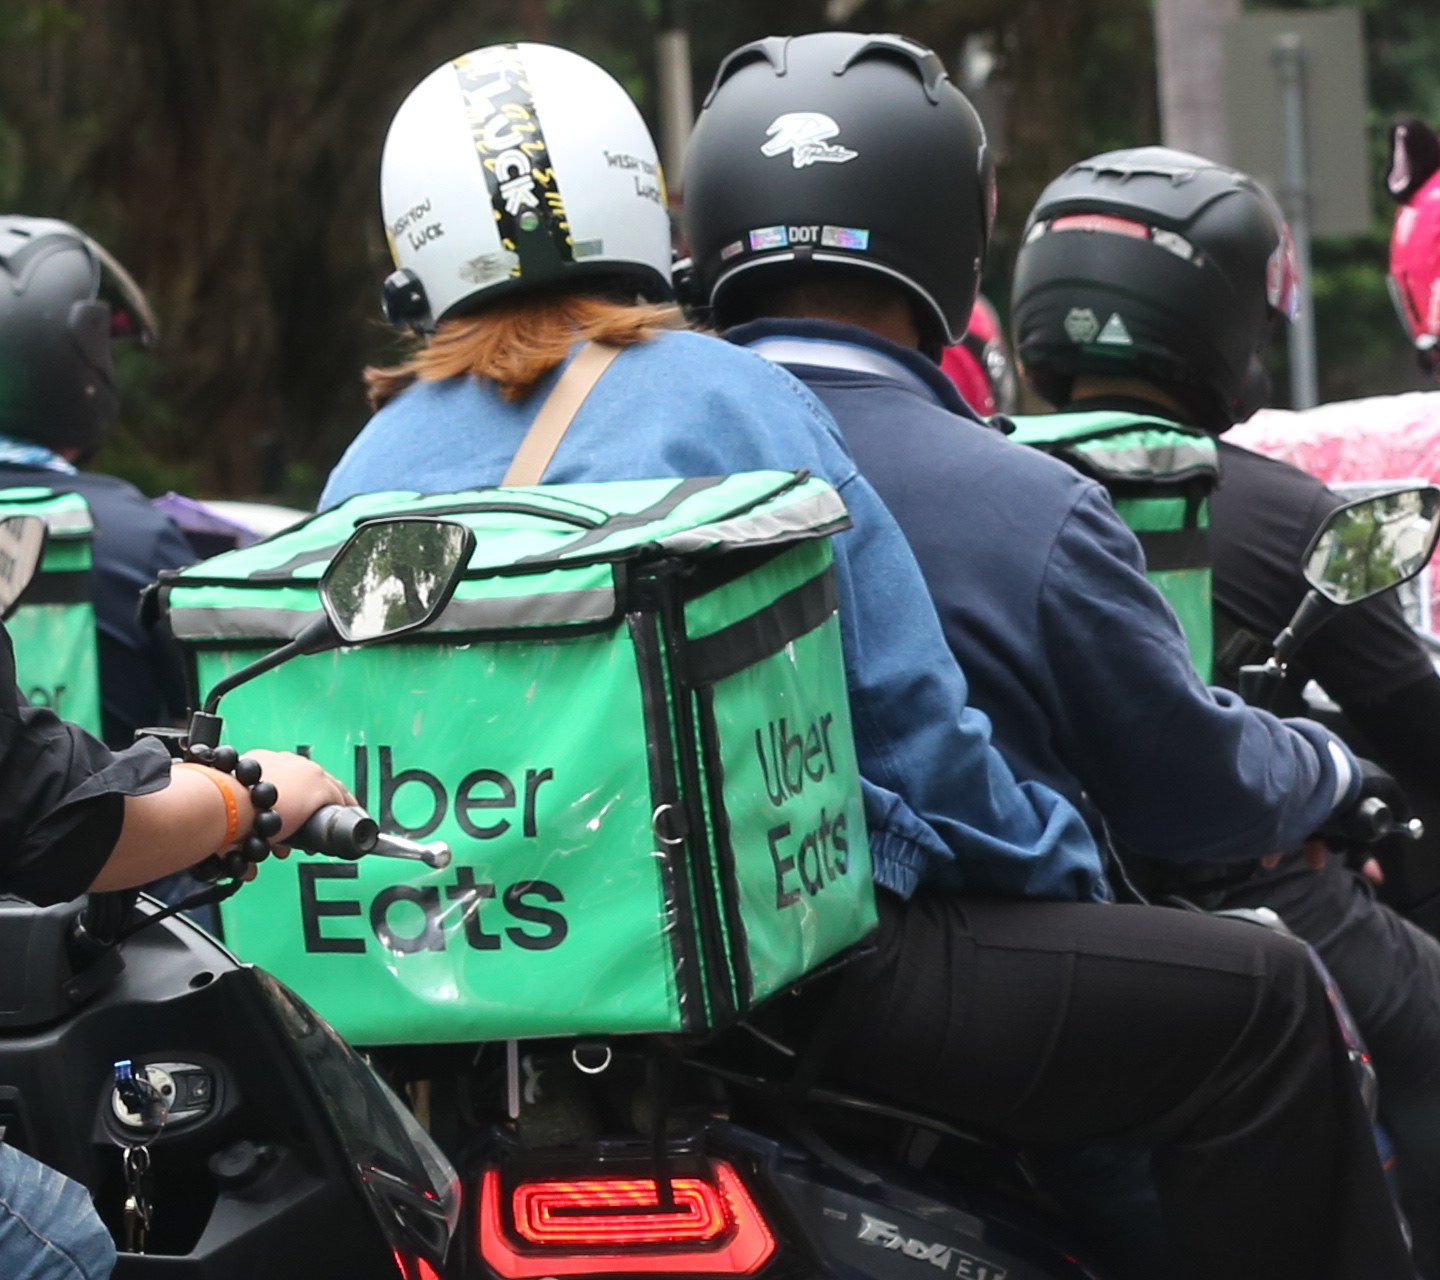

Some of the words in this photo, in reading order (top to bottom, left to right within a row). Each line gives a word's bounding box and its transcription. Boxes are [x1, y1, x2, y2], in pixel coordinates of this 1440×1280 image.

[788, 226, 821, 243] DOT
[756, 712, 835, 808] Uber
[767, 809, 848, 910] Eats
[297, 863, 569, 953] Eats
